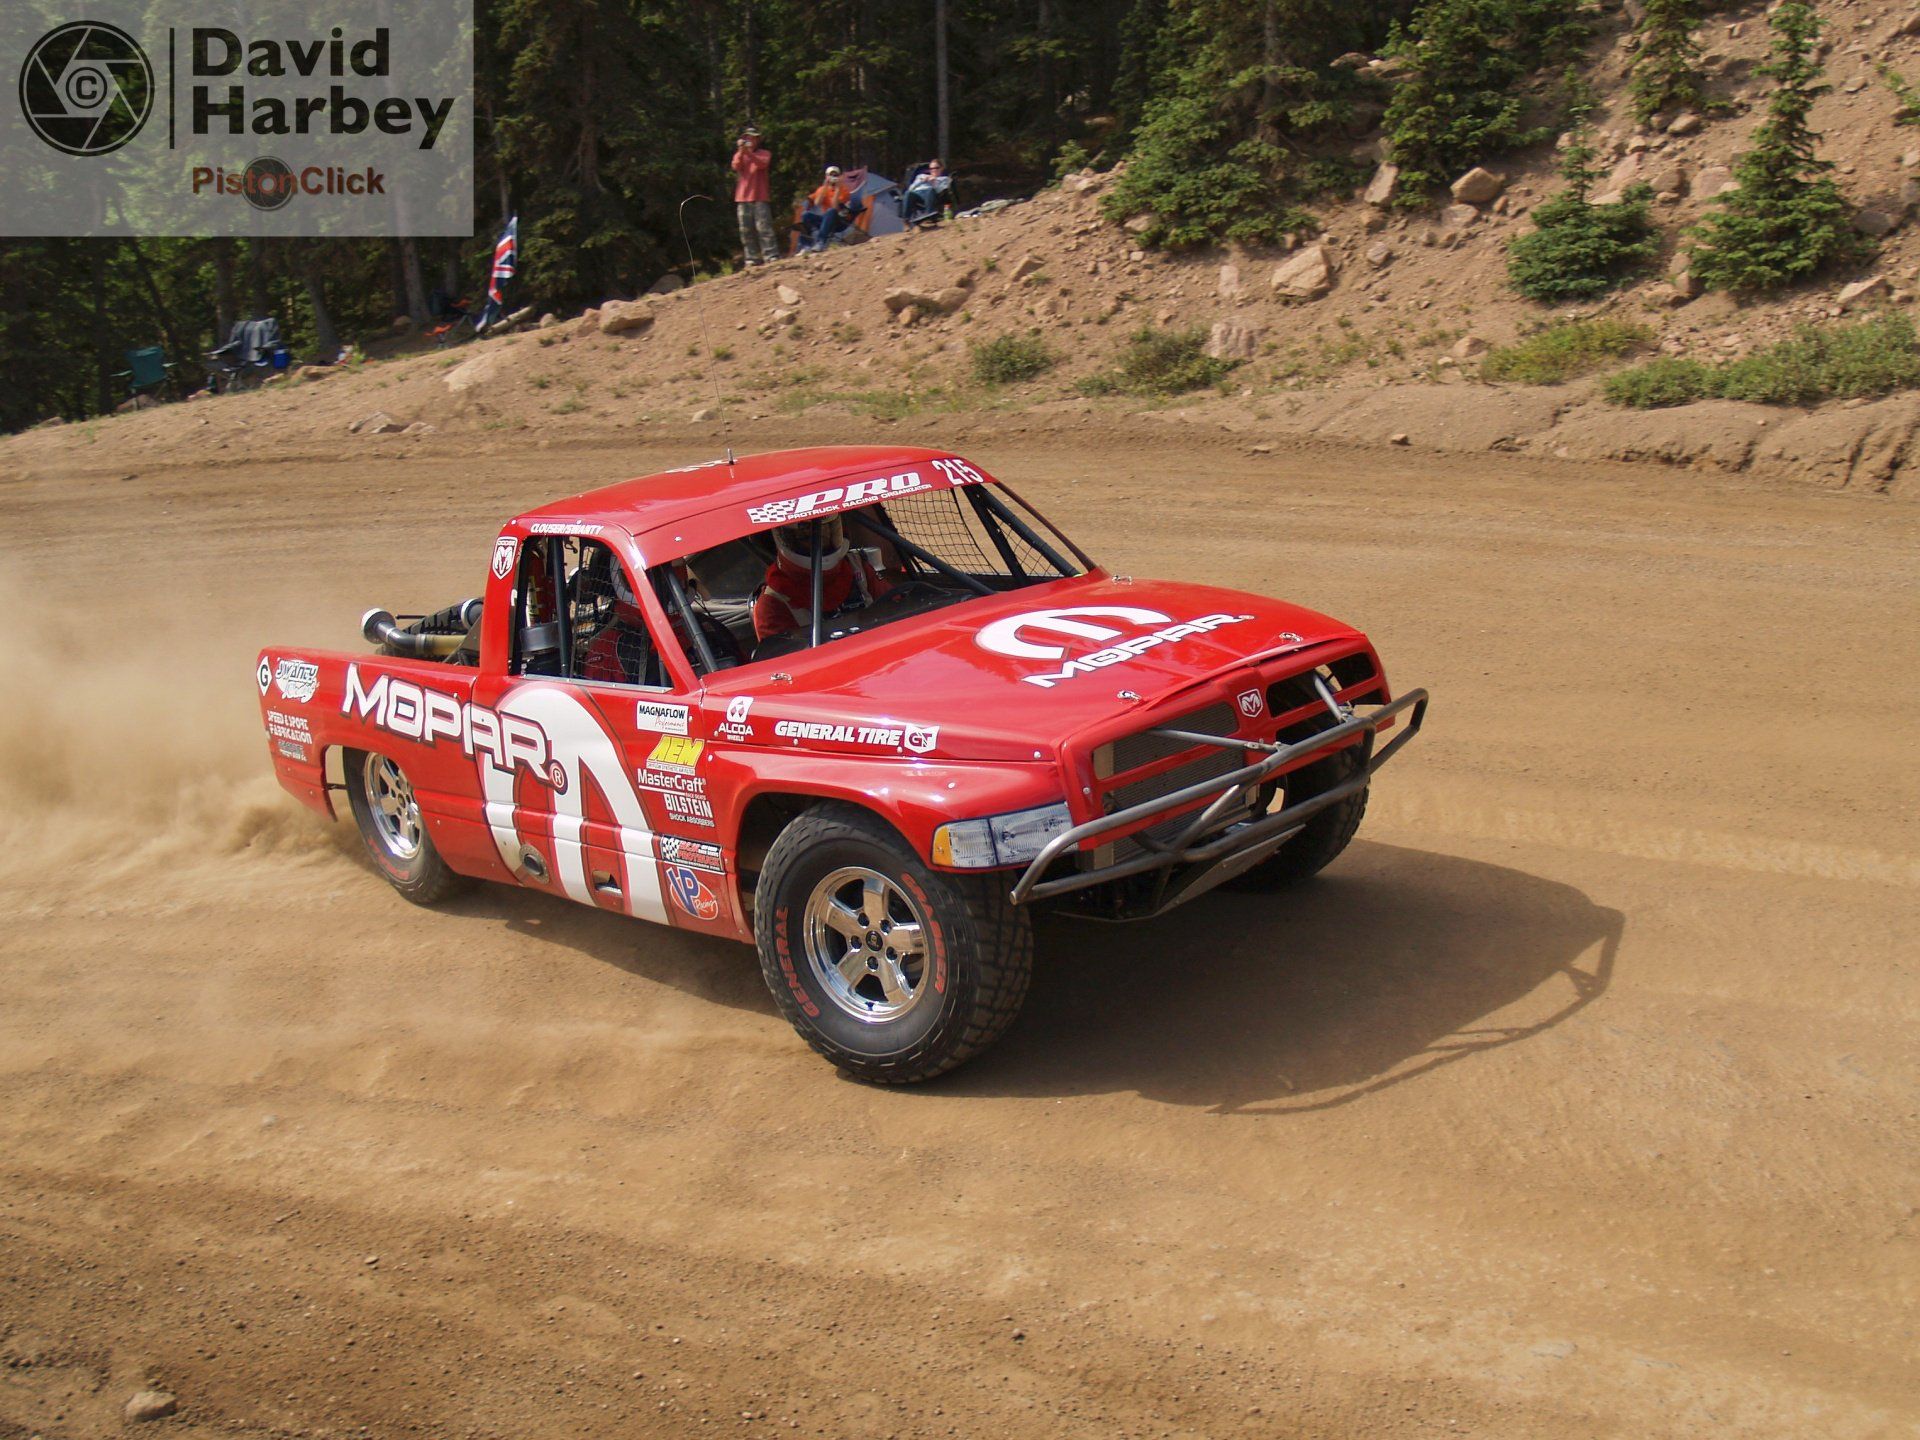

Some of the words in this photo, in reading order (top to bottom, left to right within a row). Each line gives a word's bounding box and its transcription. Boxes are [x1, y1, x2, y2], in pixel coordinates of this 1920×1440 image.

[931, 458, 985, 485] 215
[787, 504, 840, 520] PROTRUCK
[842, 495, 879, 509] RACING
[881, 483, 932, 499] ORGANIZATION
[791, 471, 922, 515] PRO
[1021, 614, 1244, 688] MOPAR
[639, 704, 686, 719] MAGNAFLOW
[718, 722, 754, 736] ALCOA
[774, 720, 857, 742] GENERAL
[857, 727, 904, 746] TIRE
[649, 734, 704, 769] AEM
[637, 767, 704, 793] MasterCraft
[664, 793, 714, 819] BILSTEIN
[902, 872, 948, 995] GRABBER
[774, 903, 820, 1018] GENERAL
